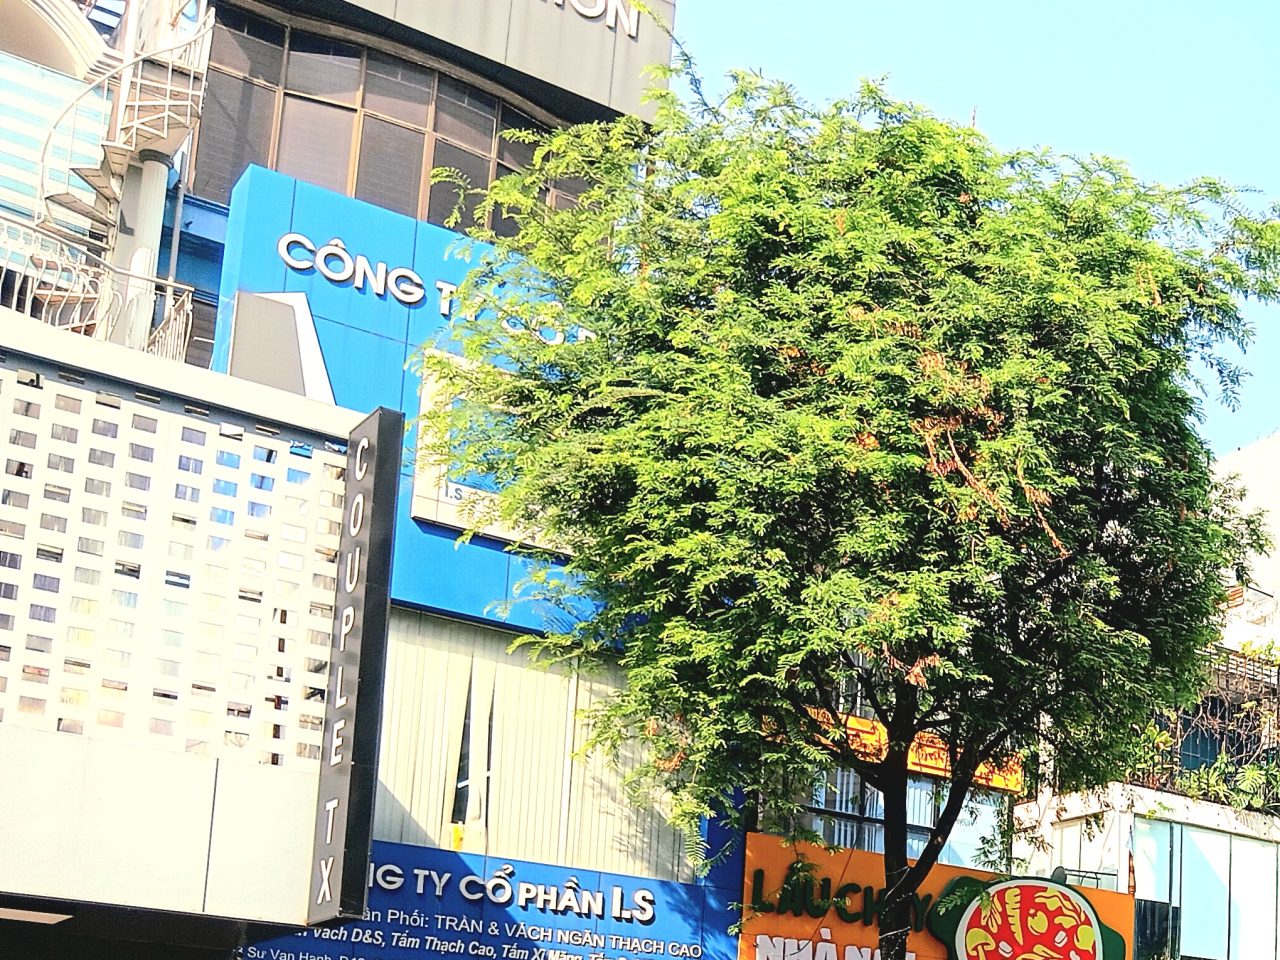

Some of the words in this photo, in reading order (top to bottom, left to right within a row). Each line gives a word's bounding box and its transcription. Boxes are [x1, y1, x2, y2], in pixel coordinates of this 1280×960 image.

[277, 231, 426, 305] CÔNG
[328, 435, 370, 768] COUPLE
[413, 868, 451, 897] TY
[459, 863, 515, 904] CỔ
[518, 875, 605, 919] PHẦN
[611, 885, 656, 924] I.S
[834, 882, 933, 933] CHY
[247, 946, 267, 958] Sư
[351, 927, 386, 948] D&S,
[391, 929, 424, 948] Tấm
[424, 935, 465, 955] Thạch
[468, 941, 497, 959] Cao,
[502, 942, 529, 960] Tấm
[387, 908, 429, 929] Phối:
[488, 921, 500, 936] &
[505, 921, 552, 943] VÁCH
[557, 928, 605, 949] NGĂN
[609, 935, 665, 956] THẠCH
[668, 943, 702, 959] CAO
